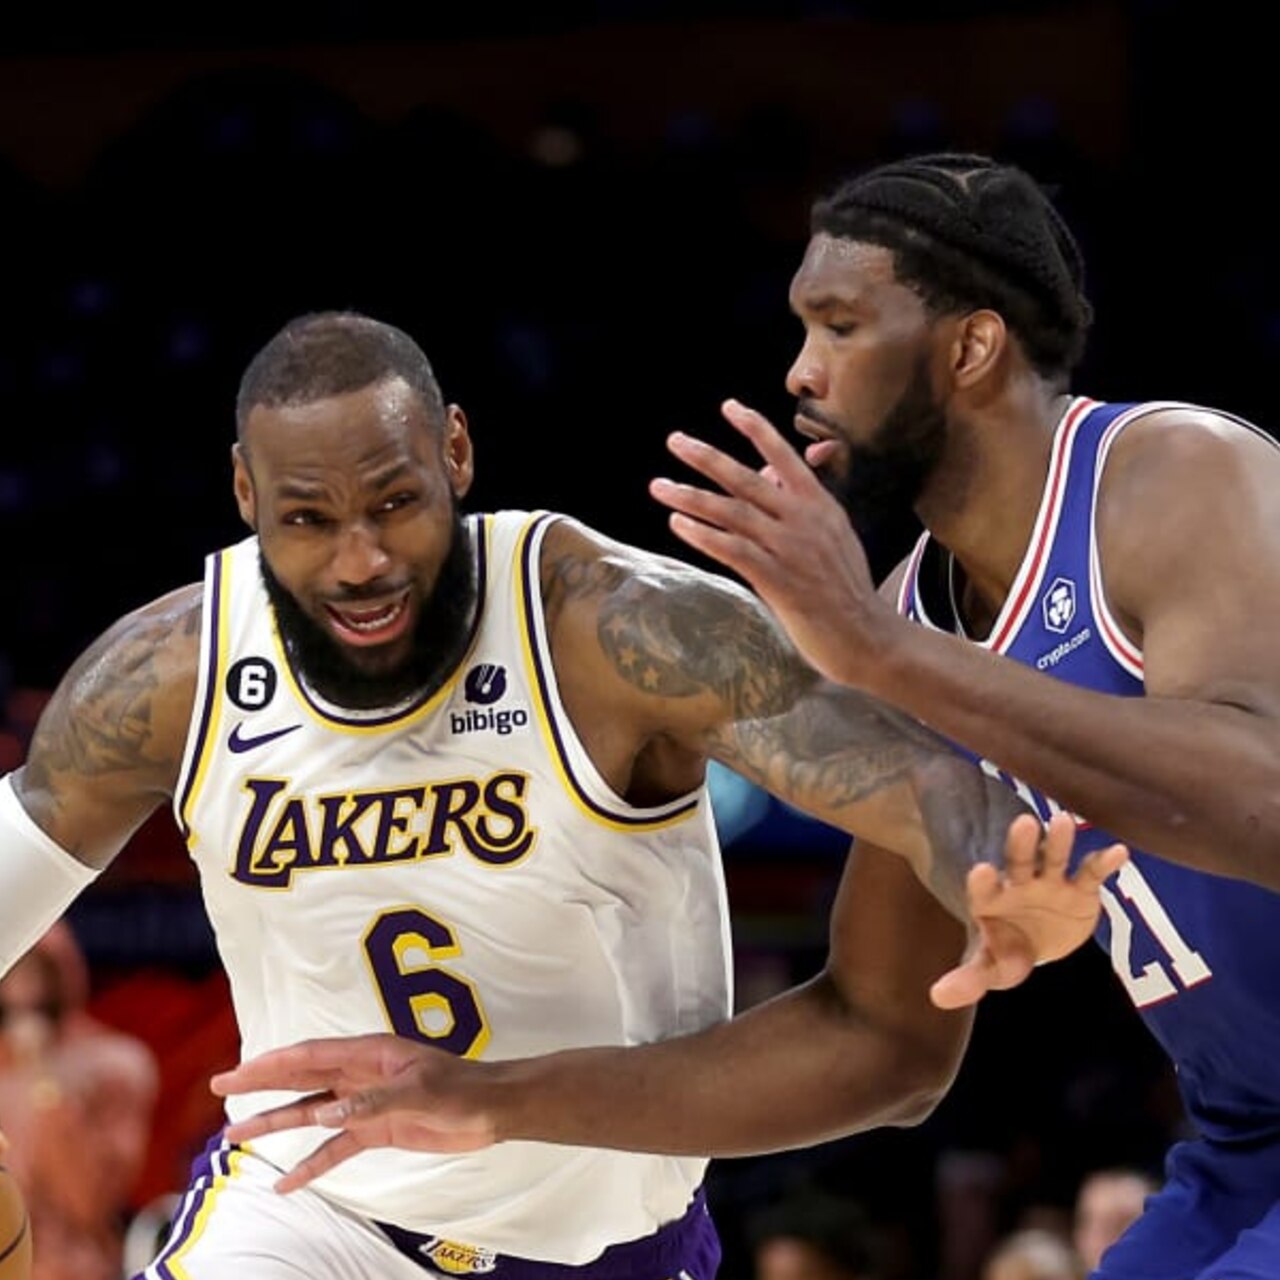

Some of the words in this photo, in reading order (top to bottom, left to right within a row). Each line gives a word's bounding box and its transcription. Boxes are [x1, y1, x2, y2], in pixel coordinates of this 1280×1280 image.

[239, 665, 267, 705] 6
[1037, 628, 1090, 670] crypto.com
[451, 708, 527, 735] bibigo
[229, 771, 536, 891] LAKERS
[1099, 858, 1212, 1008] 21
[361, 905, 491, 1060] 6
